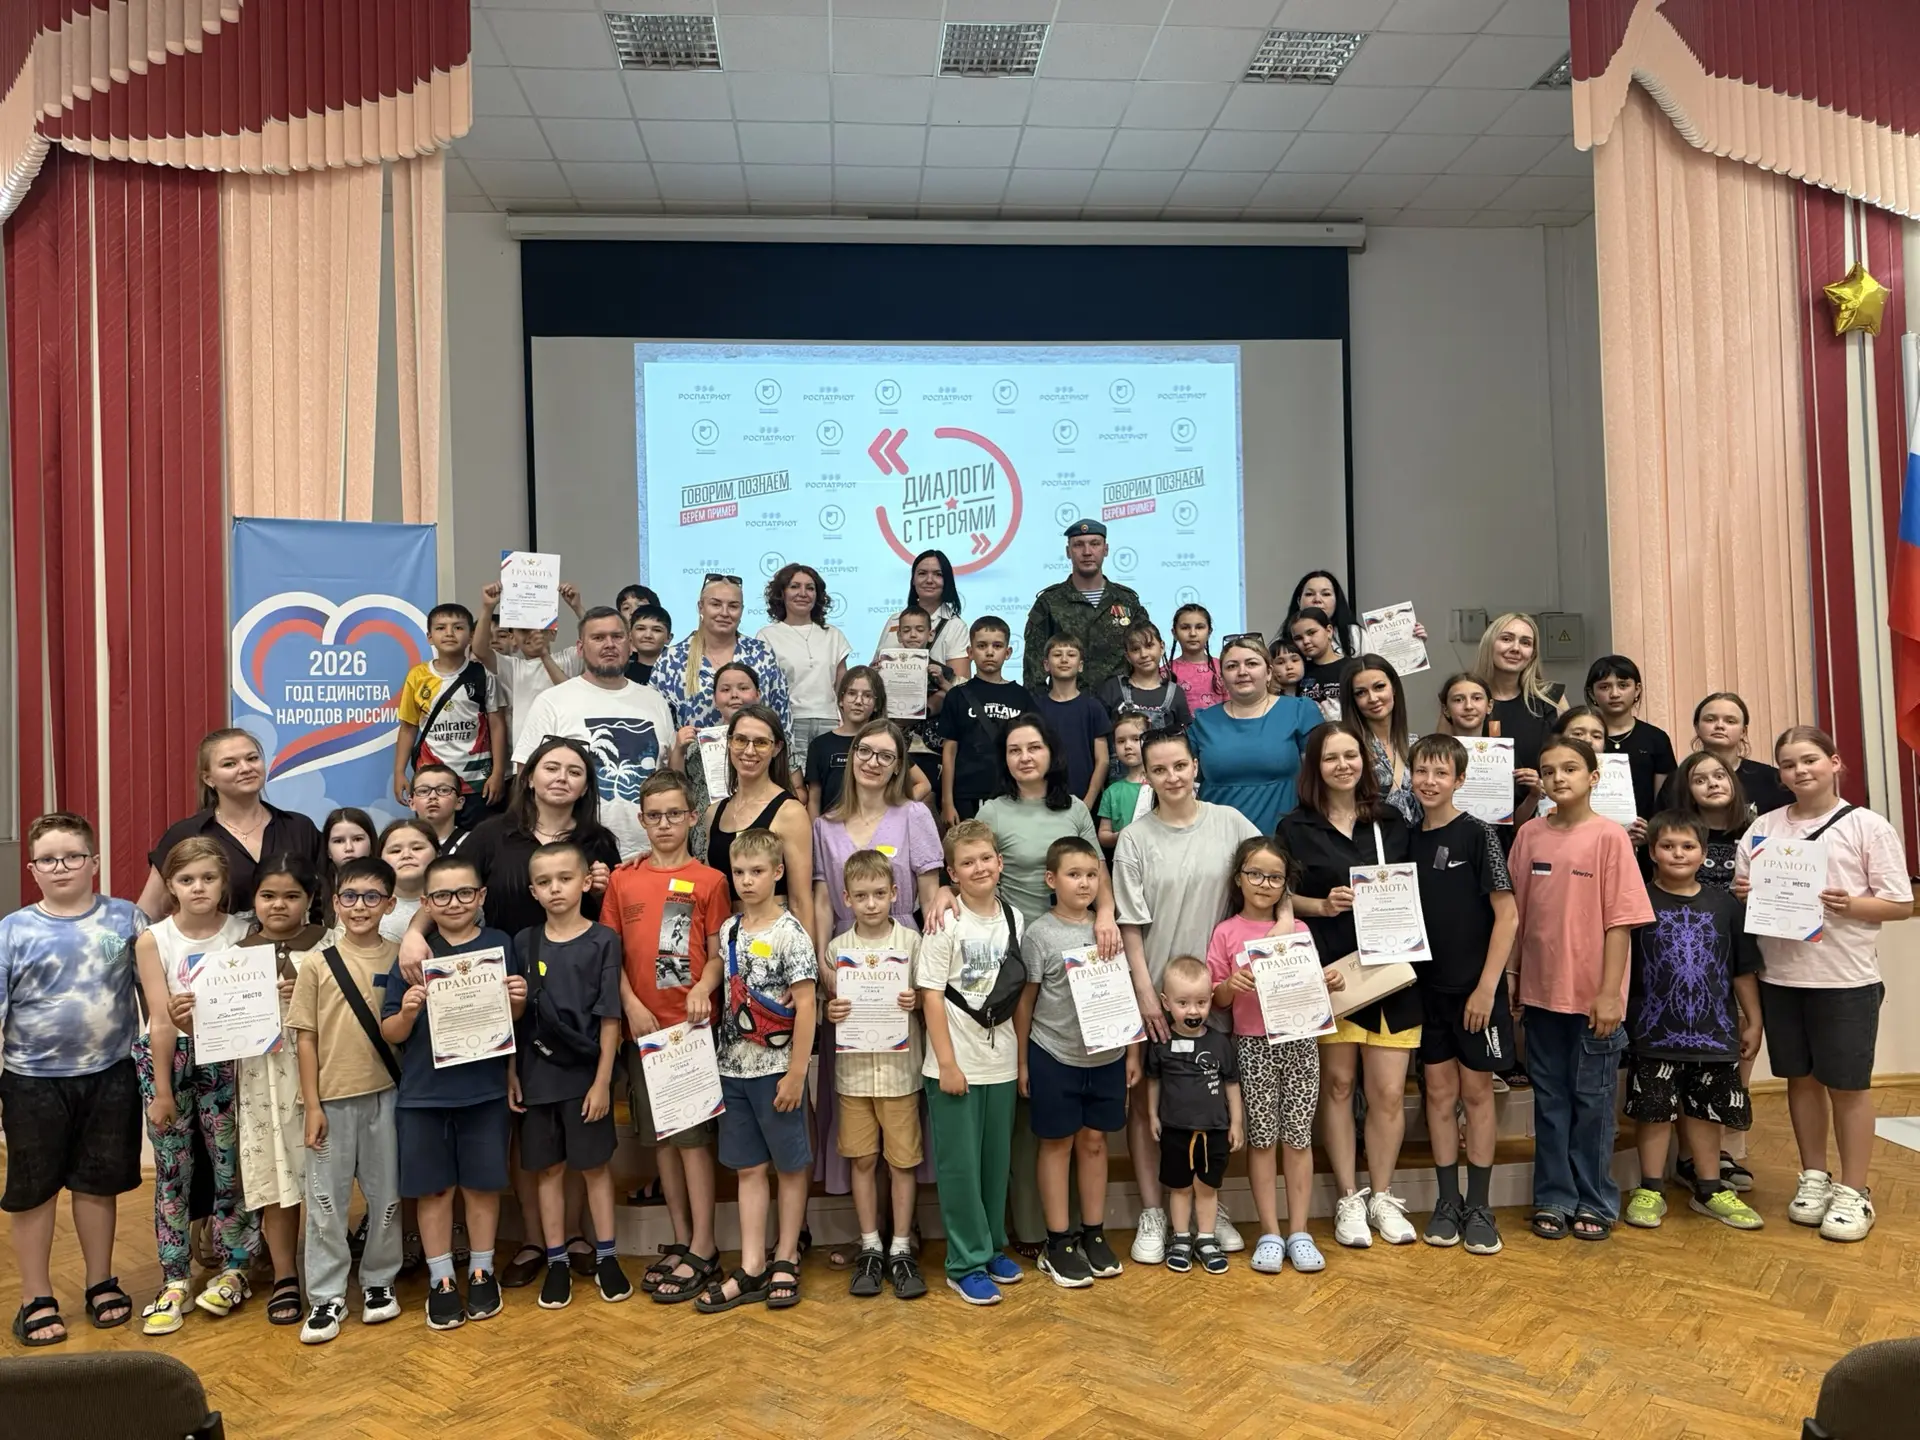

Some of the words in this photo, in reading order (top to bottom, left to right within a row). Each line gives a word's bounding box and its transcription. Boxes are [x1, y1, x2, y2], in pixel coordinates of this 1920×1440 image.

[678, 393, 731, 401] РОСПАТРИОТ
[803, 394, 855, 402] РОСПАТРИОТ
[743, 434, 795, 442] РОСПАТРИОТ
[805, 481, 857, 489] РОСПАТРИОТ
[902, 462, 995, 510] ДИАЛОГИ
[707, 504, 737, 520] ПРИМЕР
[745, 520, 798, 528] РОСПАТРИОТ
[903, 519, 913, 543] С
[919, 503, 996, 541] ГЕРОЯМИ
[511, 568, 553, 578] ГРАМОТА
[1373, 617, 1411, 633] ГРАМОТА
[309, 650, 367, 676] 2026
[885, 662, 922, 671] ГРАМОТА
[285, 685, 314, 703] ГОД
[317, 684, 391, 703] ЕДИНСТВА
[276, 708, 342, 726] НАРОДОВ
[346, 706, 400, 724] РОССИИ
[446, 731, 471, 742] BETTER
[1469, 755, 1508, 764] АМОТА
[1763, 859, 1817, 873] ГРАМОТА
[1361, 883, 1408, 894] ГРАМОТА
[1260, 954, 1311, 971] ГРАМОТА
[845, 970, 901, 981] ГРАМОТА
[1075, 962, 1122, 980] ГРАМОТА
[206, 970, 267, 987] ГРАМОТА
[437, 972, 497, 992] ГРАМОТА
[209, 997, 218, 1005] ЗА
[242, 991, 262, 1000] МЕСТО
[651, 1038, 707, 1066] ГРАМОТА
